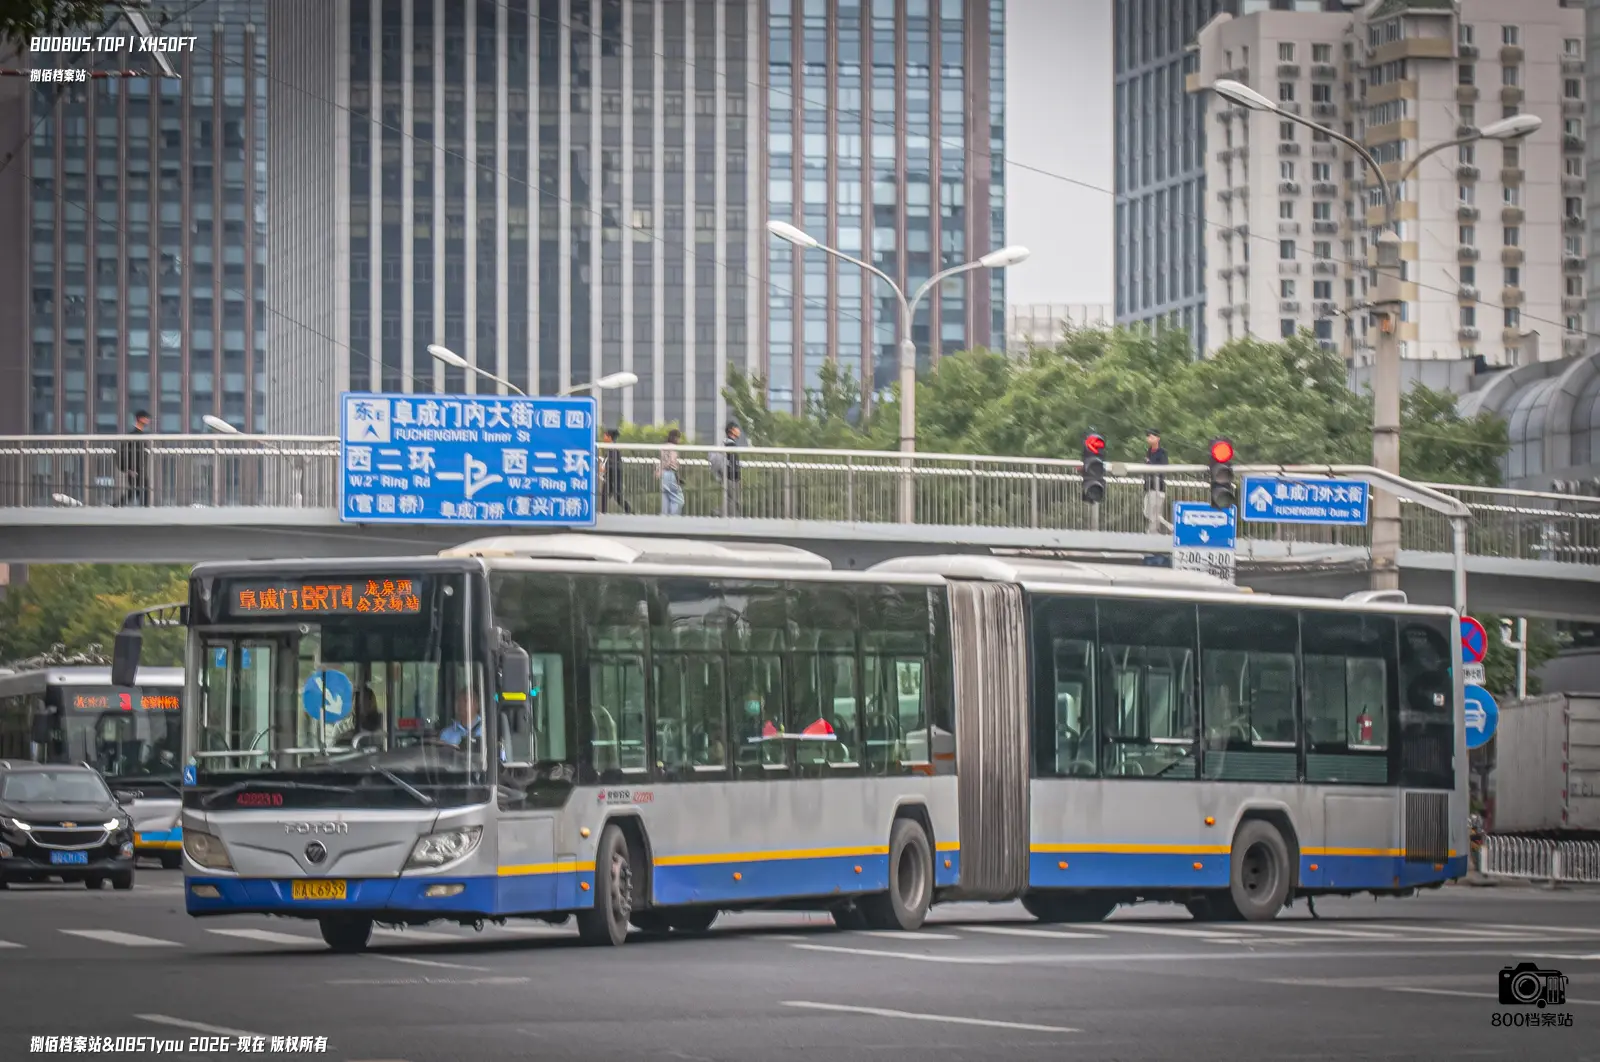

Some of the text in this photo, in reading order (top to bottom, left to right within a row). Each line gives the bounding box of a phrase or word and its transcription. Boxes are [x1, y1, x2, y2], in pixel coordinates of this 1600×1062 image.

[352, 401, 374, 422] 东
[395, 428, 531, 443] FUCHENGMEN Inner St
[347, 445, 436, 474] 西二环
[502, 447, 591, 477] 西二环
[381, 475, 408, 490] Ring
[413, 475, 431, 488] Rd
[539, 477, 567, 492] Ring
[571, 478, 588, 491] Rd
[1275, 483, 1363, 504] 阜成门外大街
[439, 501, 505, 520] 阜成门桥
[506, 495, 590, 518] (复兴门桥)
[356, 595, 421, 613] 公交场站
